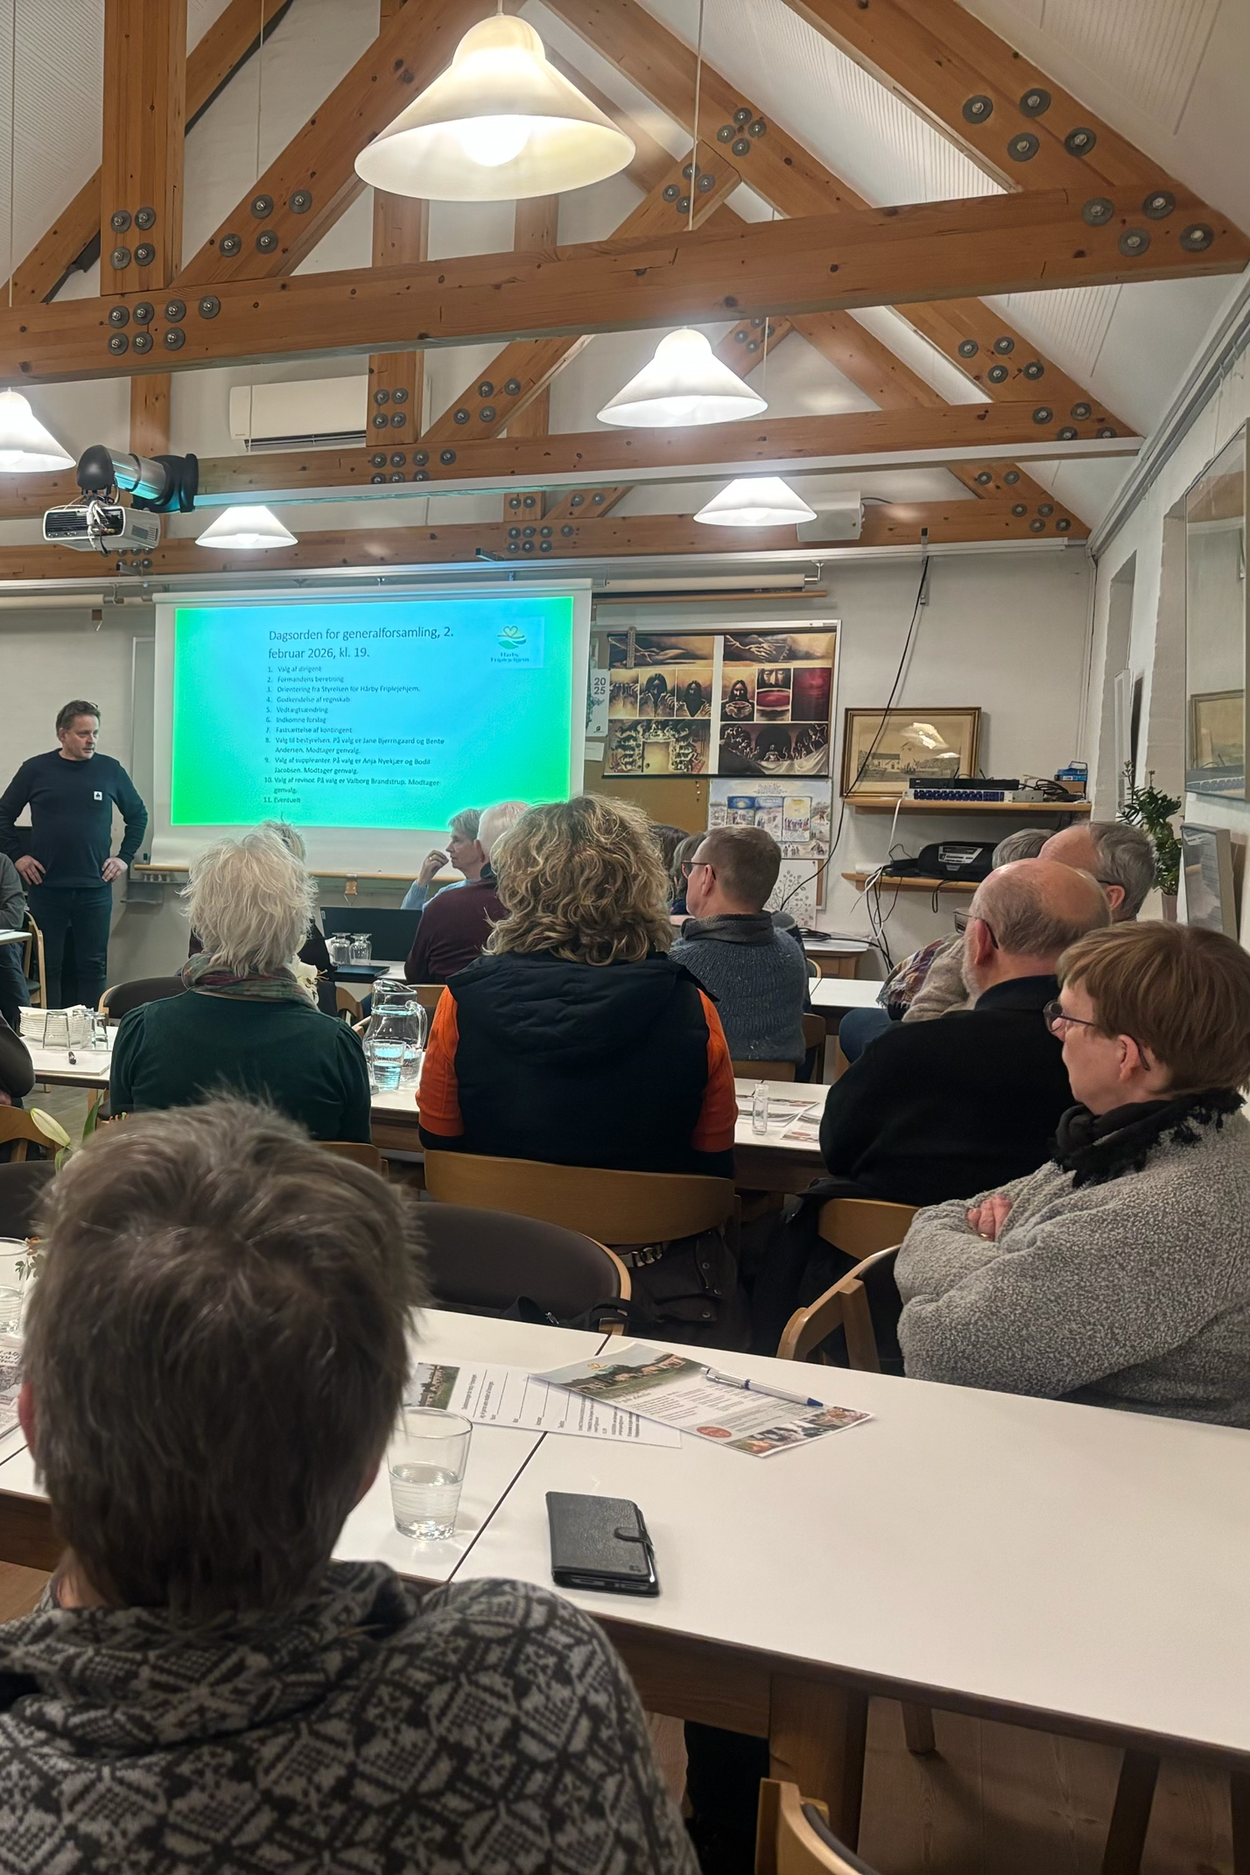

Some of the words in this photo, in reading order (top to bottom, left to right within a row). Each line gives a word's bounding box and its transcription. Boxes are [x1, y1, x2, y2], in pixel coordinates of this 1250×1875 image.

[269, 629, 323, 643] Dagsorden
[325, 628, 341, 639] for
[342, 626, 441, 642] generalforsamling,
[443, 626, 454, 637] 2.
[268, 647, 305, 659] februar
[307, 647, 336, 660] 2026,
[339, 646, 351, 658] kl.
[353, 646, 370, 658] 19.
[594, 677, 606, 686] 20
[593, 686, 606, 695] 25
